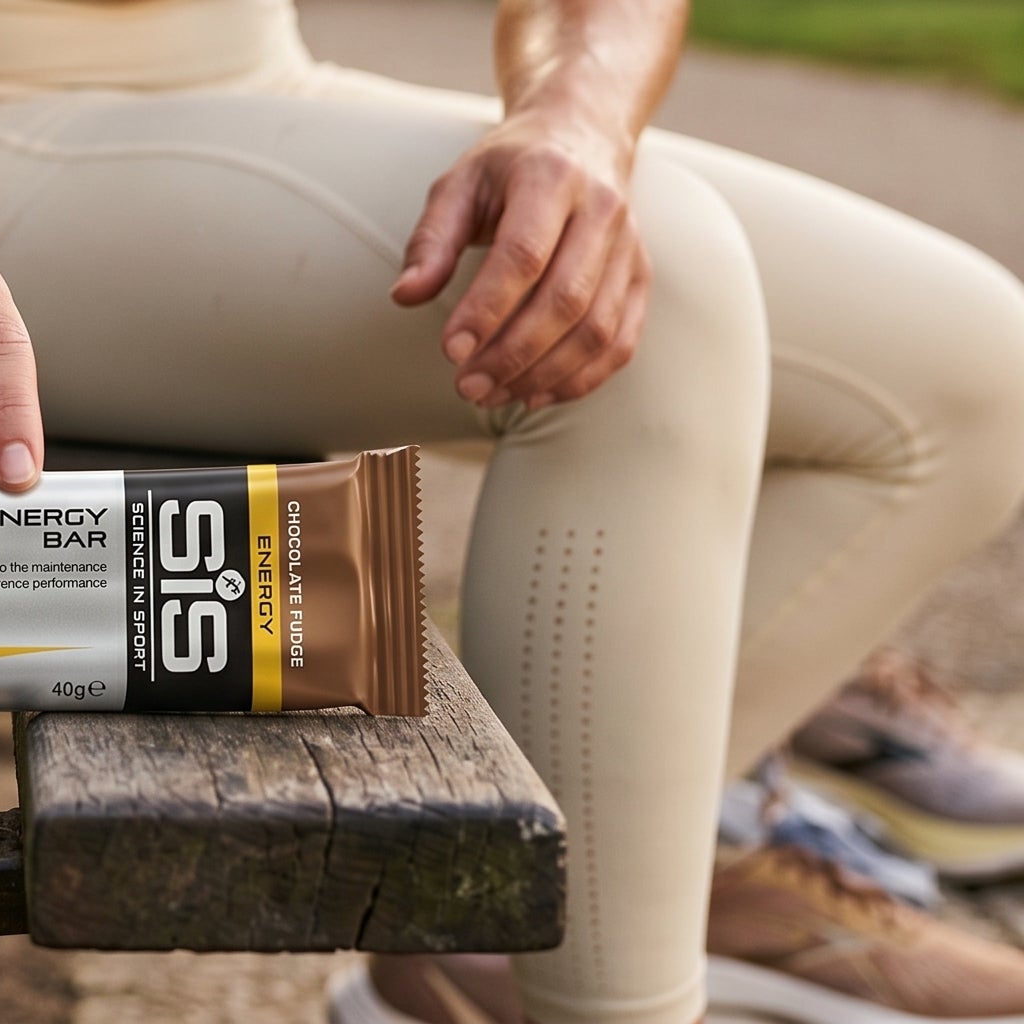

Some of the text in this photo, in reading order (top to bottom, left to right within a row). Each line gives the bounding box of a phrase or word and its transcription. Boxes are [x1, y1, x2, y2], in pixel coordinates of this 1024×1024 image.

[10, 562, 28, 573] the
[32, 562, 107, 573] maintenance
[43, 531, 107, 548] BAR
[33, 578, 107, 591] performance
[131, 502, 146, 671] SCIENCE IN SPORT
[257, 535, 274, 635] ENERGY
[287, 501, 304, 668] CHOCOLATE FUDGE
